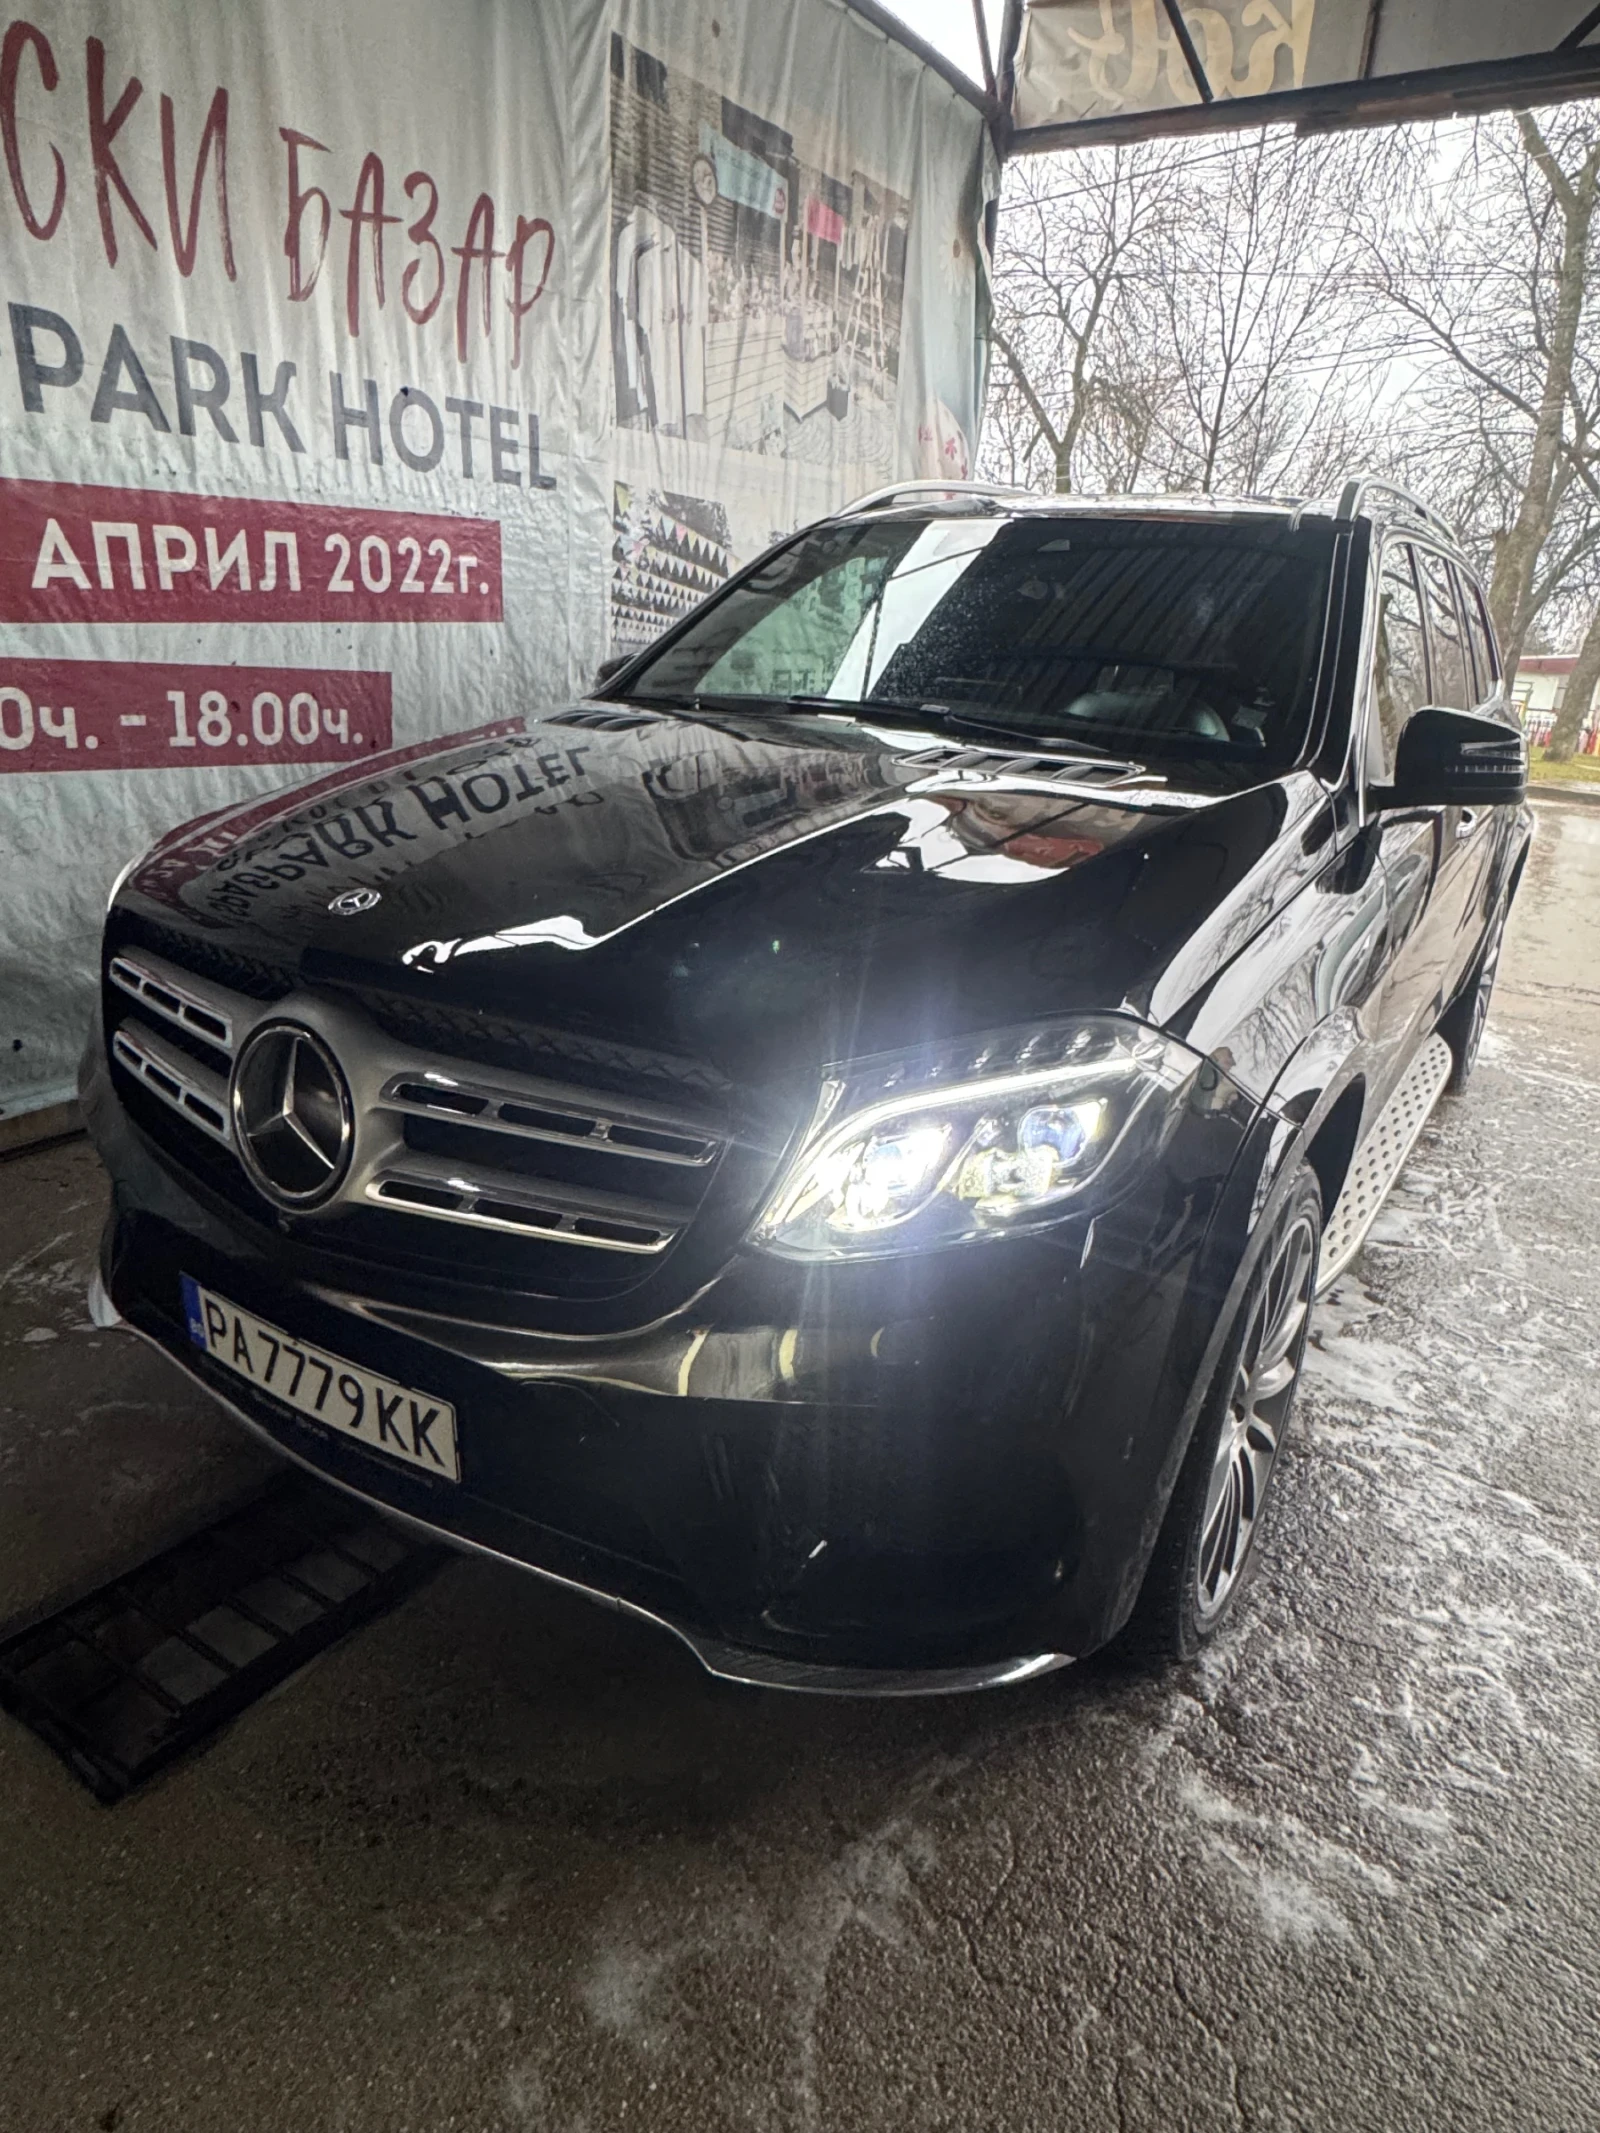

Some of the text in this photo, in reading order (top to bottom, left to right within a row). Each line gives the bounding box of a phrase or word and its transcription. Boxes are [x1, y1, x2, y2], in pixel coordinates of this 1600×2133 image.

[0, 20, 555, 369] СКИ БАЗАР
[9, 302, 557, 489] PARK HOTEL
[31, 518, 490, 595] АПРИЛ 2022г.
[167, 690, 364, 748] 18.00ч.
[204, 1298, 446, 1469] PA7779KK
